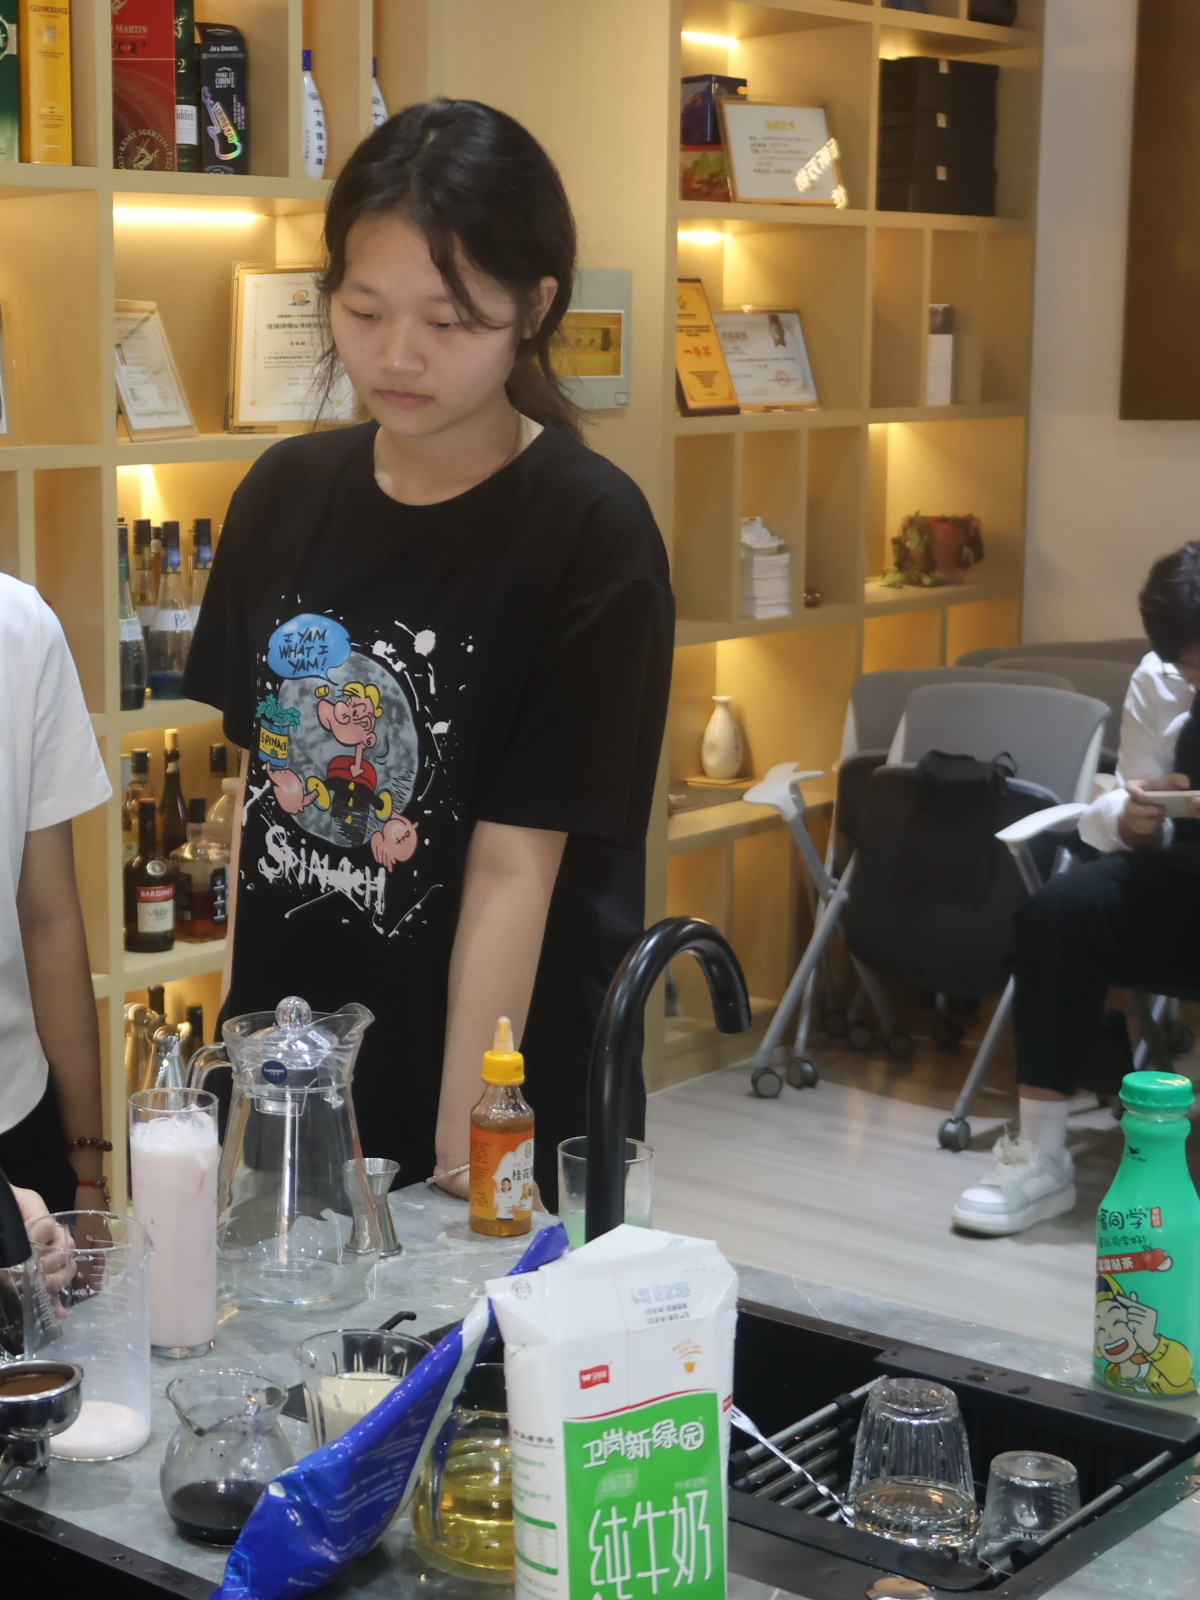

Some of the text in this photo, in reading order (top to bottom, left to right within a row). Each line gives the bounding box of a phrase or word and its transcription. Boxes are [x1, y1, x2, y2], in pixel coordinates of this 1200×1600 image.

[115, 24, 148, 34] MARTIN
[139, 128, 169, 148] MARTIN
[283, 629, 328, 643] I YAM
[279, 645, 330, 660] WHAT I
[288, 657, 327, 674] YAM!
[260, 733, 288, 751] SPINACH
[140, 887, 173, 898] BARDINET
[583, 1418, 705, 1469] 卫岗新绿园
[588, 1490, 712, 1600] 纯牛奶
